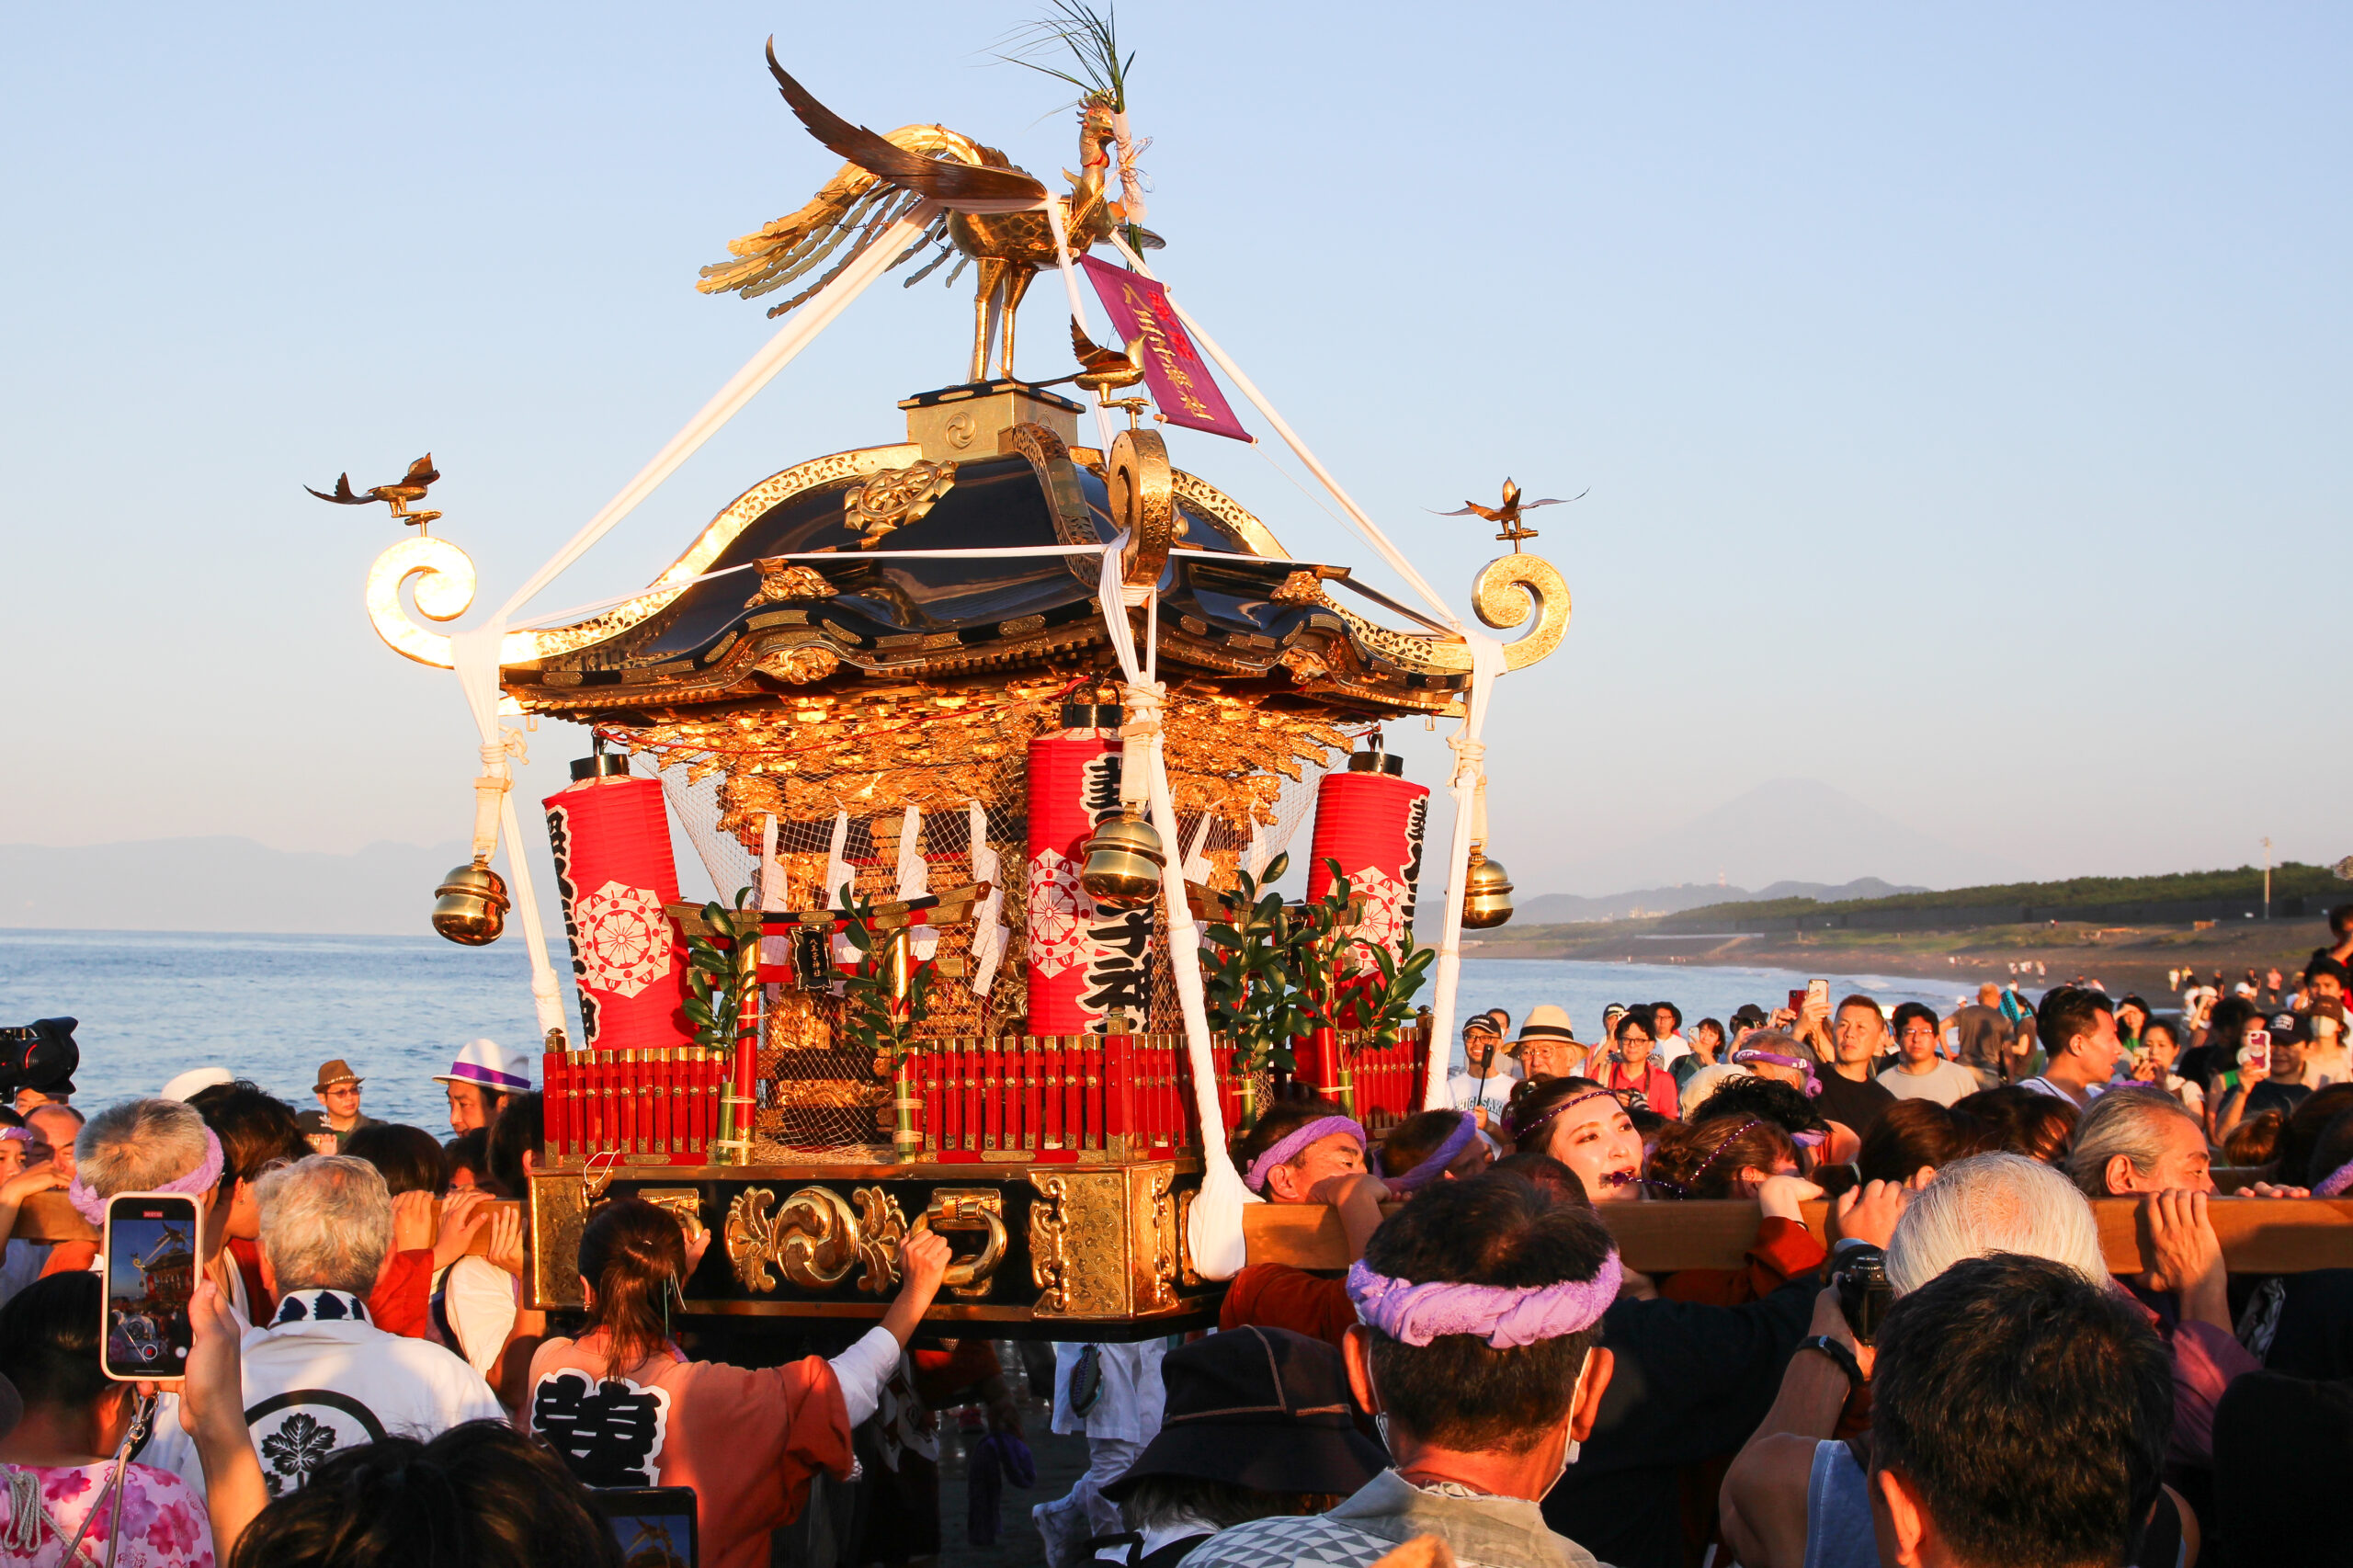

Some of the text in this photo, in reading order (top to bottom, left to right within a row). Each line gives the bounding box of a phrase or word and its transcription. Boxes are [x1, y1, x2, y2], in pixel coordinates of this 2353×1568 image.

[1121, 282, 1215, 421] 八王子神社
[810, 938, 821, 976] 八王子神社
